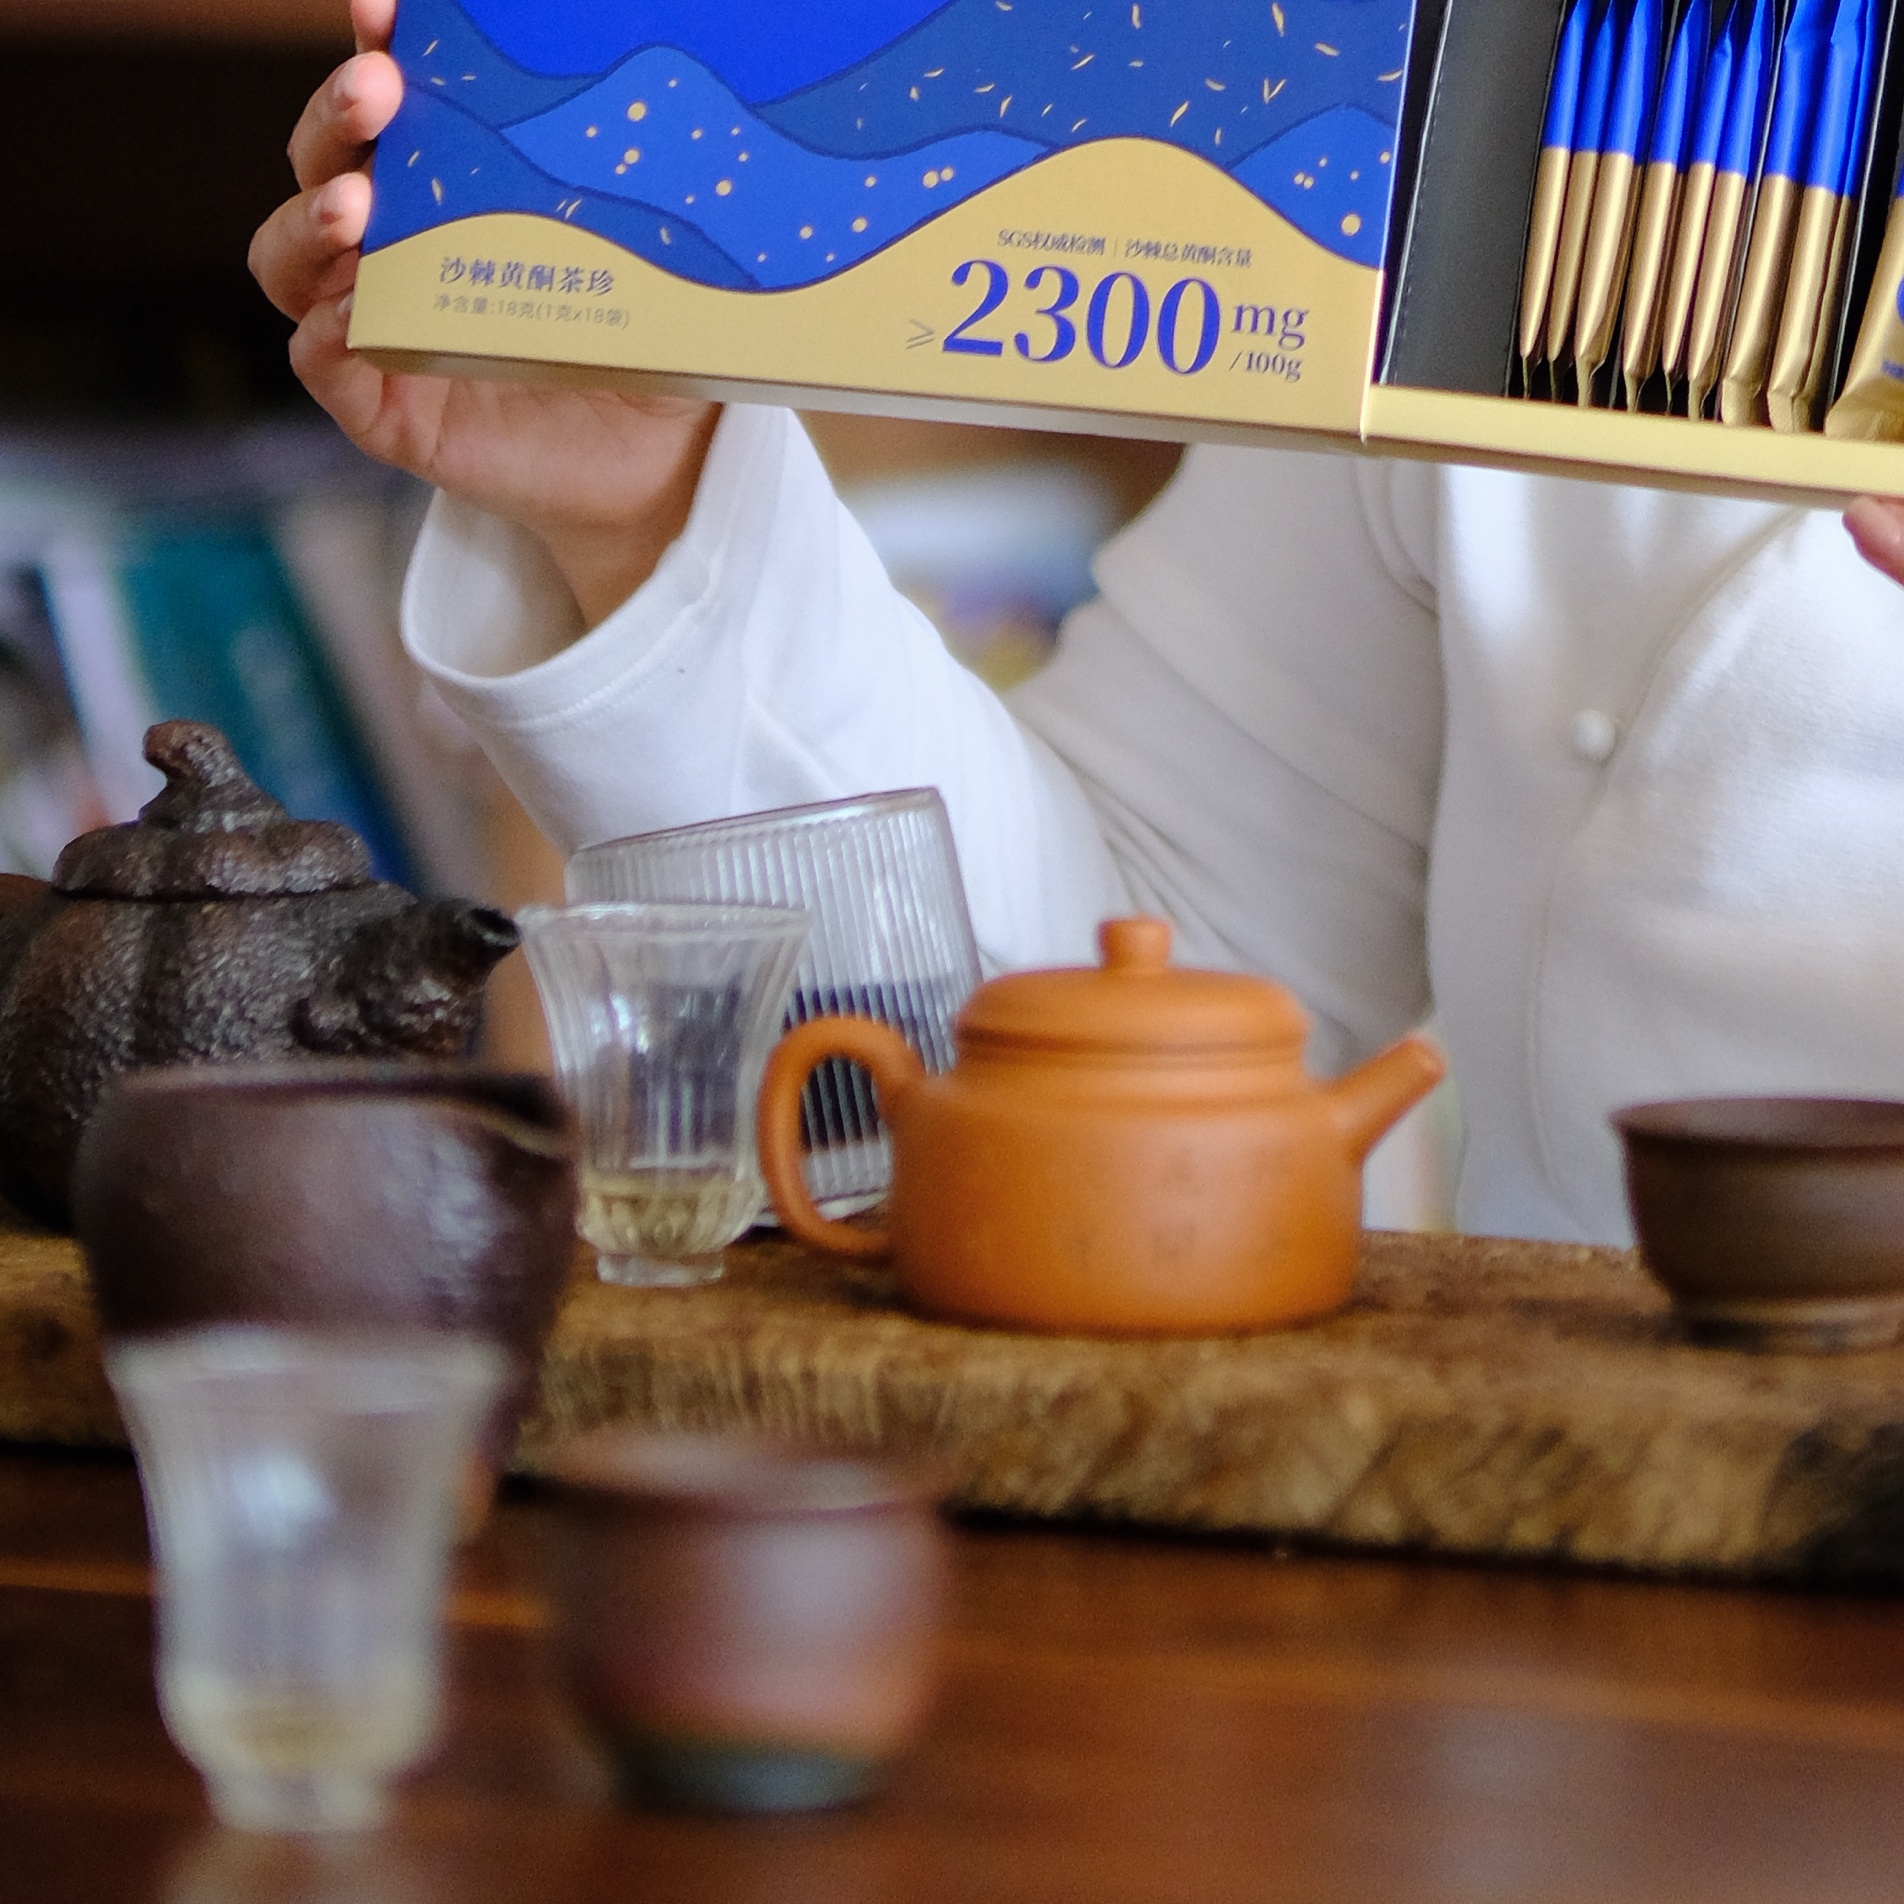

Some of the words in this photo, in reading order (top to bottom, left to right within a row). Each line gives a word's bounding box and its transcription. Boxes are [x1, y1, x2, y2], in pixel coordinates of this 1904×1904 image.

[440, 256, 615, 297] 沙棘黄酮茶珍
[1231, 302, 1310, 351] mg
[1229, 352, 1302, 383] /100g
